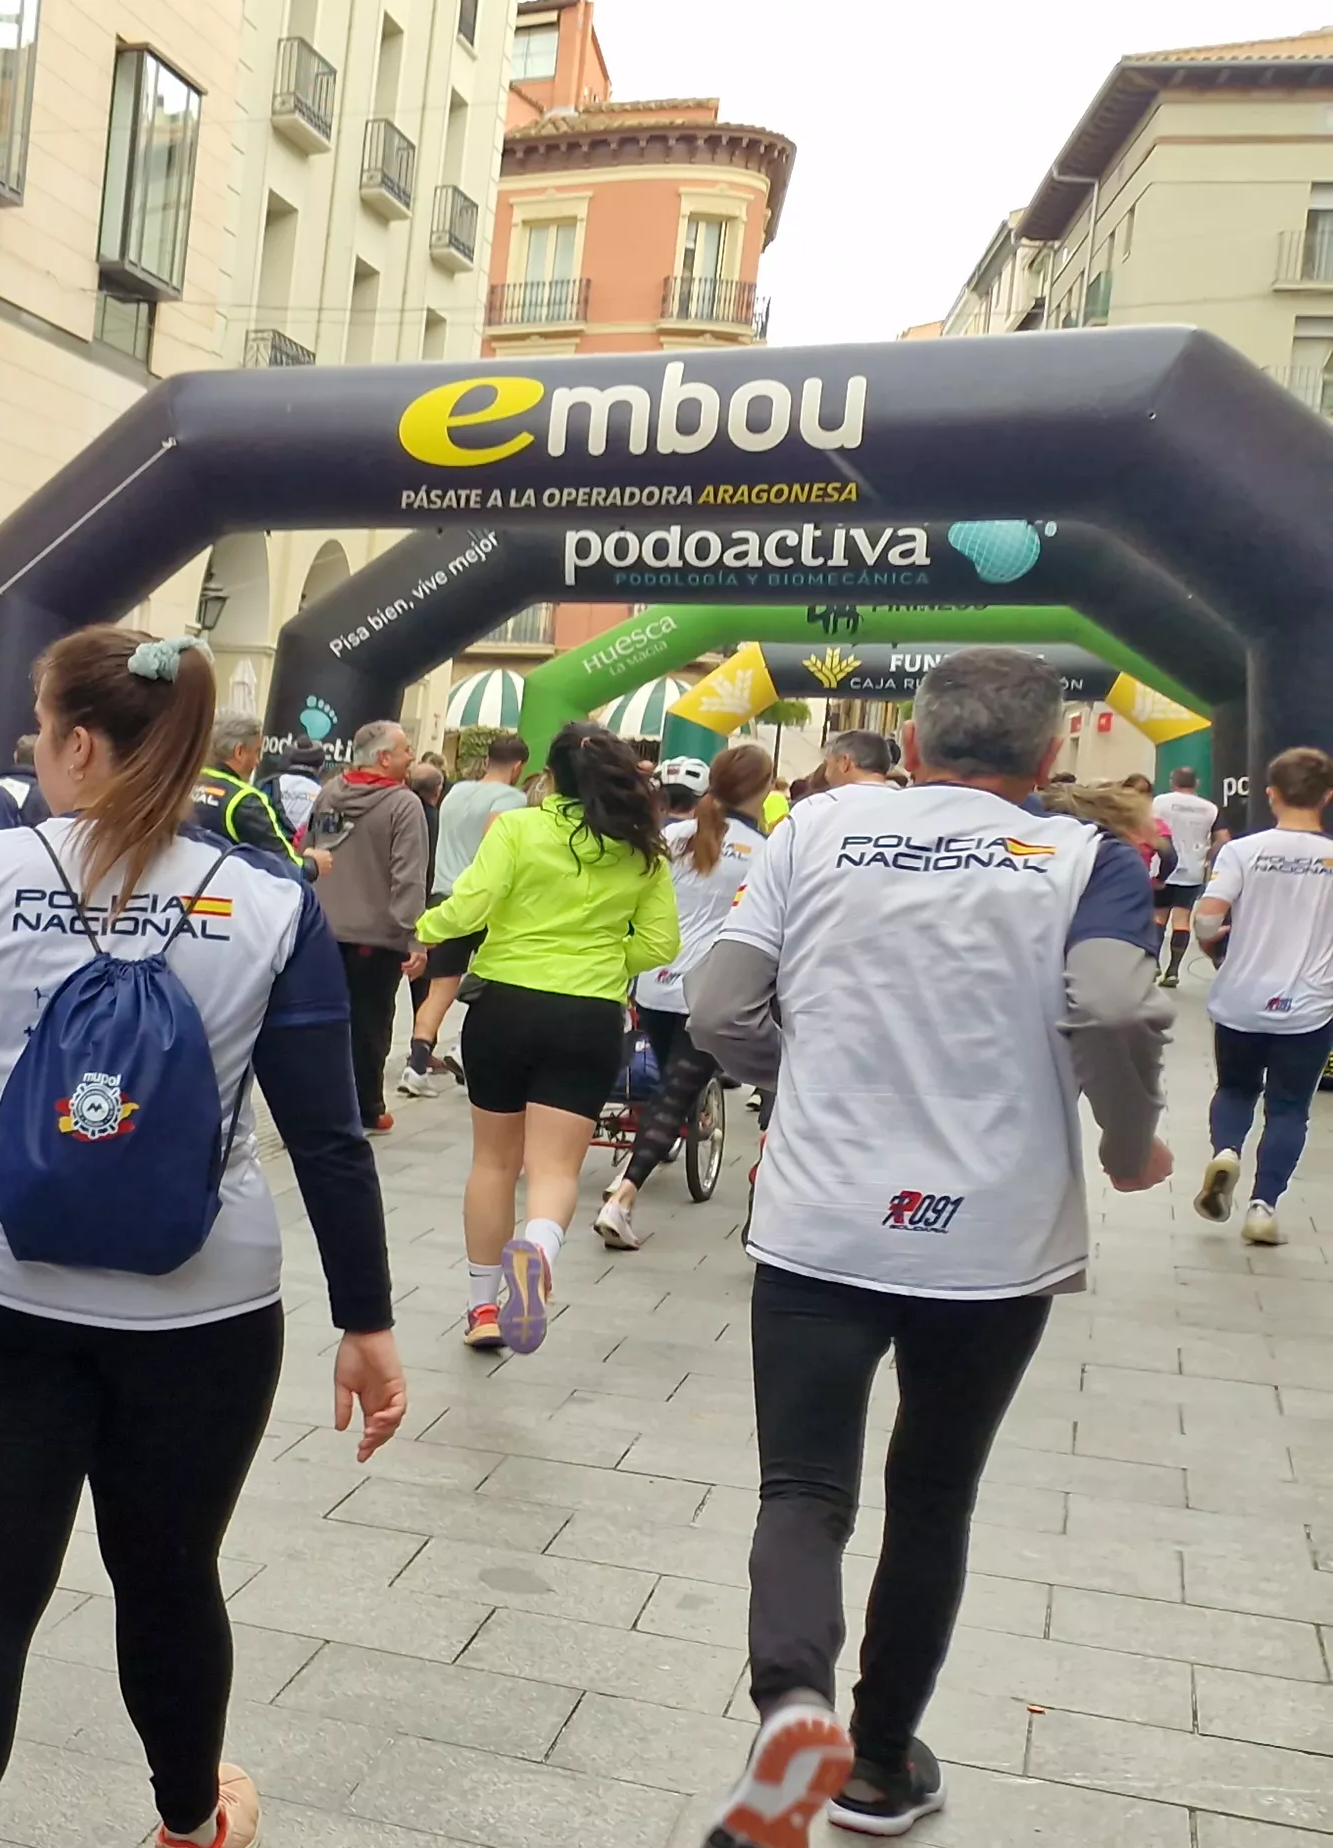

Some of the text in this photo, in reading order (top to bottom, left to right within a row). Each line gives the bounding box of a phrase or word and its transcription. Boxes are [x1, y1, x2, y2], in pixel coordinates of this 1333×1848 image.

[397, 361, 868, 468] embou
[399, 481, 859, 511] PÁSATE A LA OPERADORA ARAGONESA
[564, 522, 932, 585] podoactiva
[746, 572, 759, 586] Y
[328, 530, 499, 659] Pisa bien, vive mejor
[849, 675, 897, 691] CAJA
[840, 834, 1009, 854] POLICIA
[835, 851, 1049, 874] NACIONAL
[14, 888, 186, 915] POLICIA
[11, 912, 231, 942] NACIONAL
[82, 1071, 121, 1087] mupol
